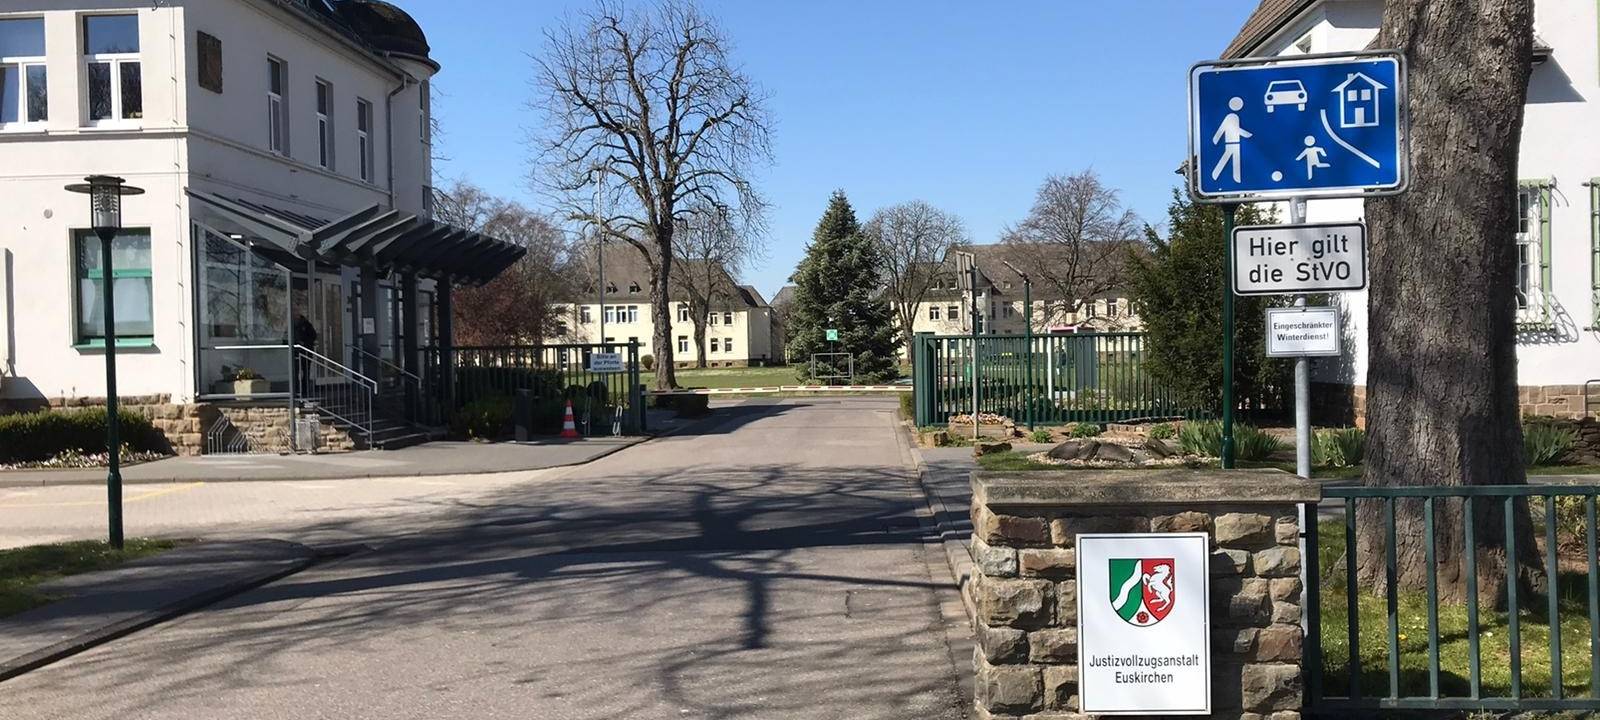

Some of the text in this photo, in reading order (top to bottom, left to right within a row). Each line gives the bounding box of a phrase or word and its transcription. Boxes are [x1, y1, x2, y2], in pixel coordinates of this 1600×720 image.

[1249, 234, 1348, 259] Hier gilt
[1249, 261, 1351, 283] die StVO
[1277, 332, 1329, 341] Winterdienst!
[1089, 654, 1199, 669] Justizvollzugsanstalt
[1115, 671, 1174, 684] Euskirchen
